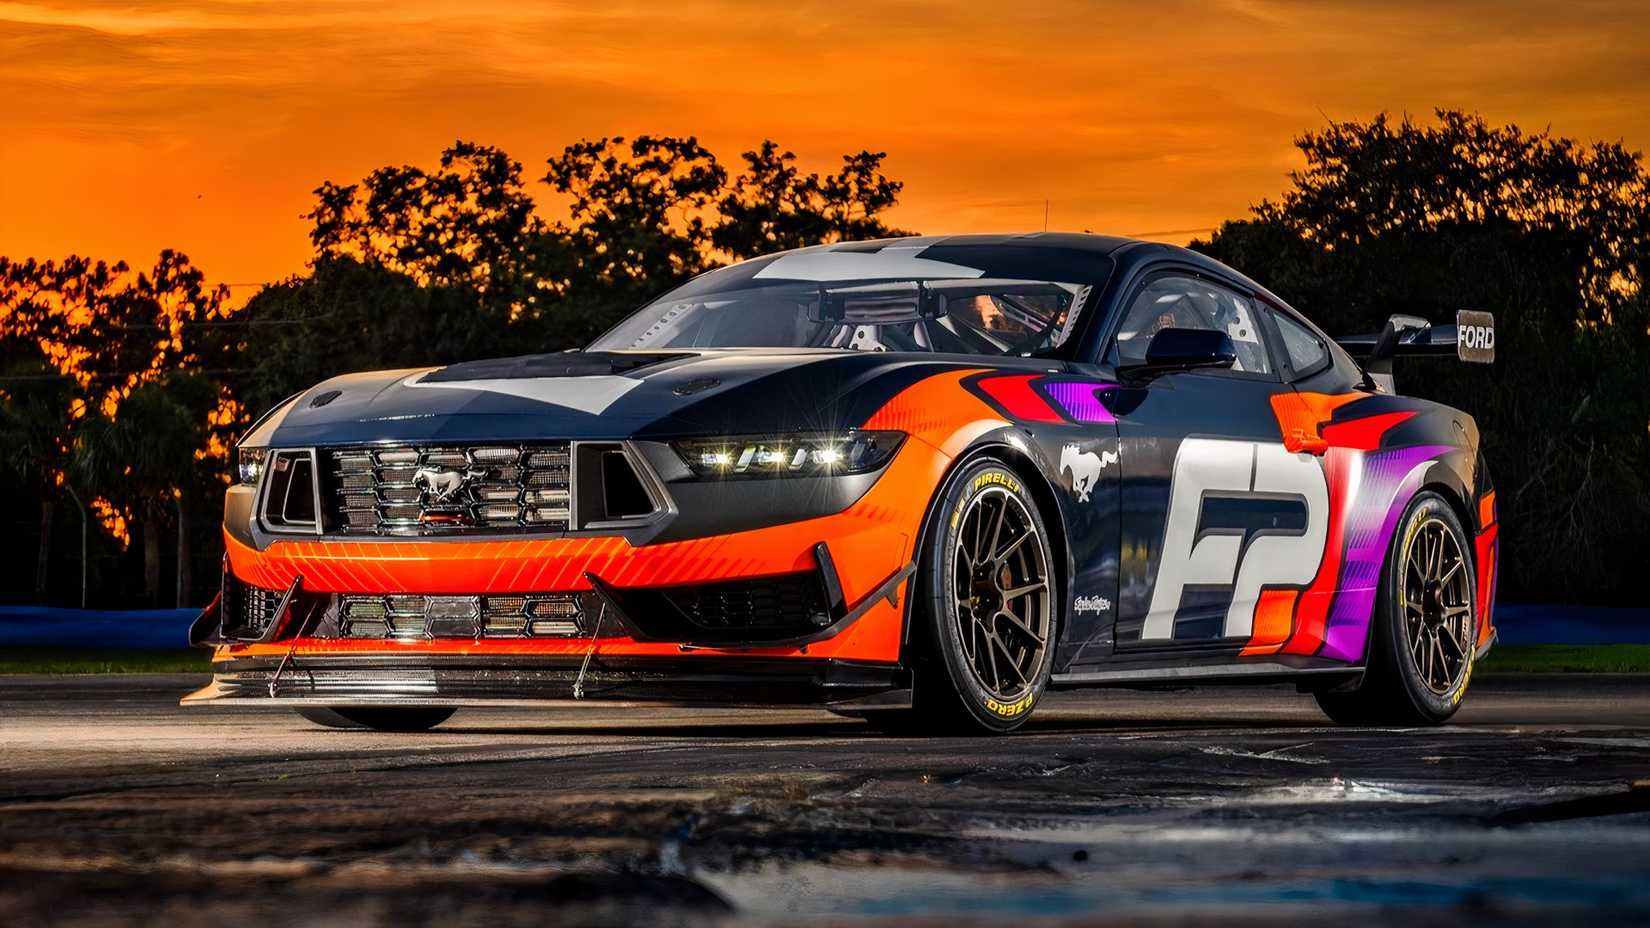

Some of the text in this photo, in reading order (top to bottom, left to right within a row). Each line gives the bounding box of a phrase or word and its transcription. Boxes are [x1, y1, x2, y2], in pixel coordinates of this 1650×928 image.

[1458, 325, 1494, 349] FORD
[974, 472, 1021, 493] PIRELLI
[1141, 437, 1329, 640] FP
[986, 699, 1026, 717] ZERO
